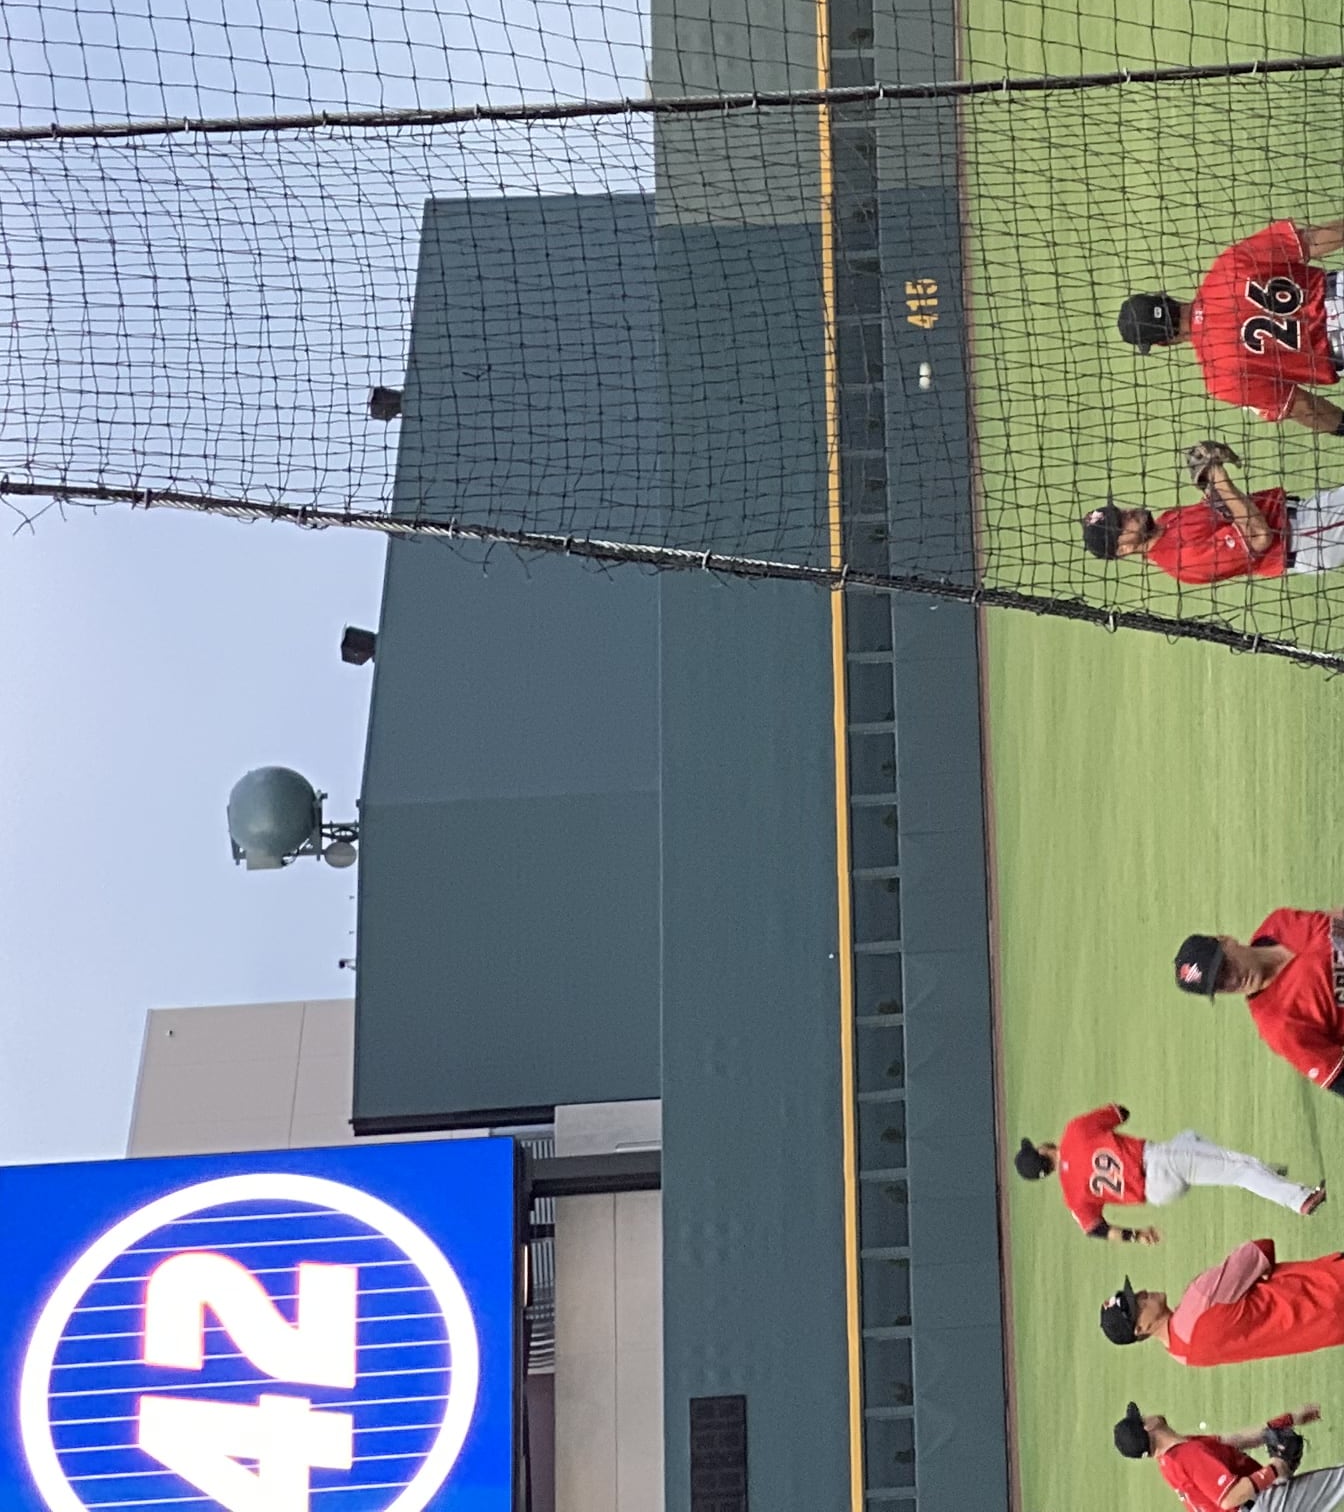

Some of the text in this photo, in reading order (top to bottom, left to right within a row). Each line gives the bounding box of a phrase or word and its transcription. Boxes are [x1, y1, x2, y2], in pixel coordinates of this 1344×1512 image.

[904, 278, 939, 329] 415
[1240, 276, 1304, 354] 26
[1089, 1147, 1125, 1200] 29
[136, 1250, 358, 1512] 42
